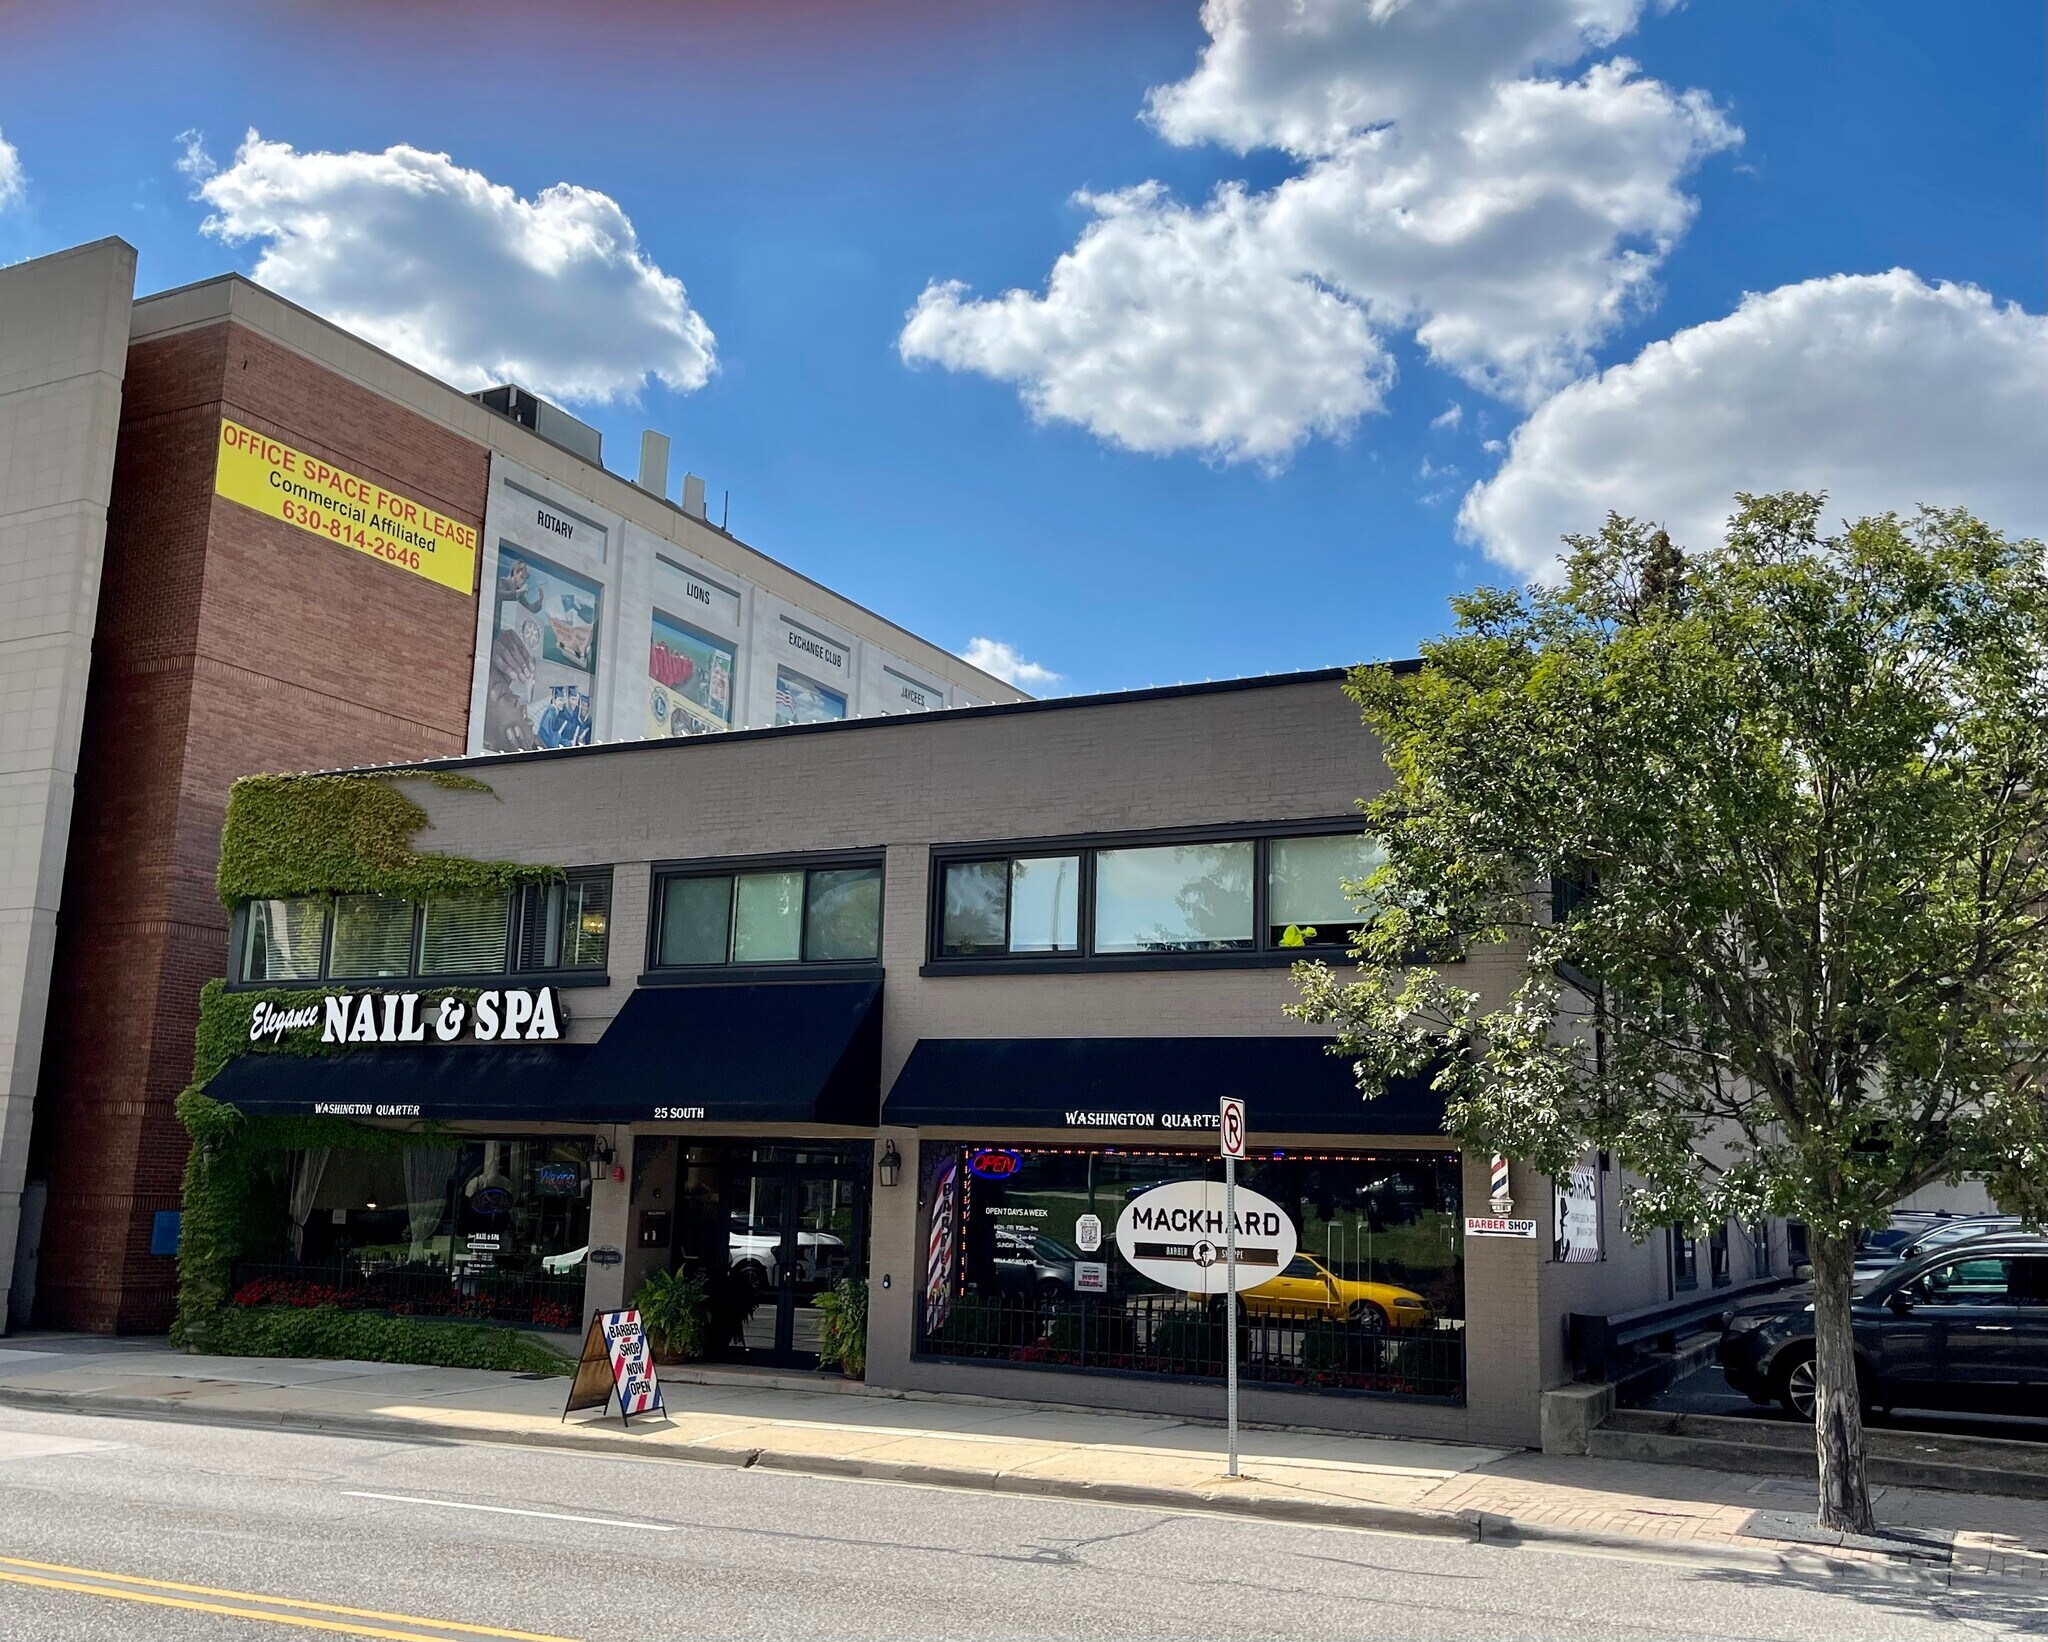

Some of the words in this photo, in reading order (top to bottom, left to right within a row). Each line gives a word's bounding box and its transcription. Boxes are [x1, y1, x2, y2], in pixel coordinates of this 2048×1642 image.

[223, 424, 297, 473] OFFICE
[303, 459, 371, 505] SPACE
[377, 492, 417, 525] FOR
[422, 511, 475, 550] LEASE
[269, 471, 366, 524] Commercial
[369, 514, 436, 553] Affiliated
[537, 510, 573, 540] ROTARY
[282, 499, 421, 570] 630-814-2646
[686, 581, 711, 606] LIONS
[788, 631, 824, 660] EXCHANGE
[824, 648, 842, 668] CLUB
[900, 686, 925, 707] JAYCEES
[249, 1001, 319, 1043] Elegance
[320, 993, 425, 1044] NAIL
[435, 996, 466, 1041] &
[474, 986, 560, 1041] SPA
[314, 1102, 373, 1115] WASHINGTON
[375, 1104, 420, 1116] QUARTER
[654, 1106, 669, 1119] 25
[669, 1107, 705, 1119] SOUTH
[1065, 1110, 1155, 1127] WASHINGTON
[1161, 1113, 1221, 1128] QUARTE
[973, 1154, 1016, 1173] OPEN
[985, 1207, 1002, 1216] OPEN
[1007, 1207, 1024, 1216] DAYS
[1029, 1208, 1048, 1217] WEEK
[1132, 1206, 1280, 1237] MACKHARD
[1468, 1219, 1506, 1230] BARBER
[1508, 1221, 1534, 1231] SHOP
[1221, 1249, 1244, 1259] SPE
[609, 1322, 641, 1339] BARBER
[620, 1341, 640, 1357] SHOP
[626, 1361, 645, 1376] NOW
[630, 1380, 652, 1396] OPEN
